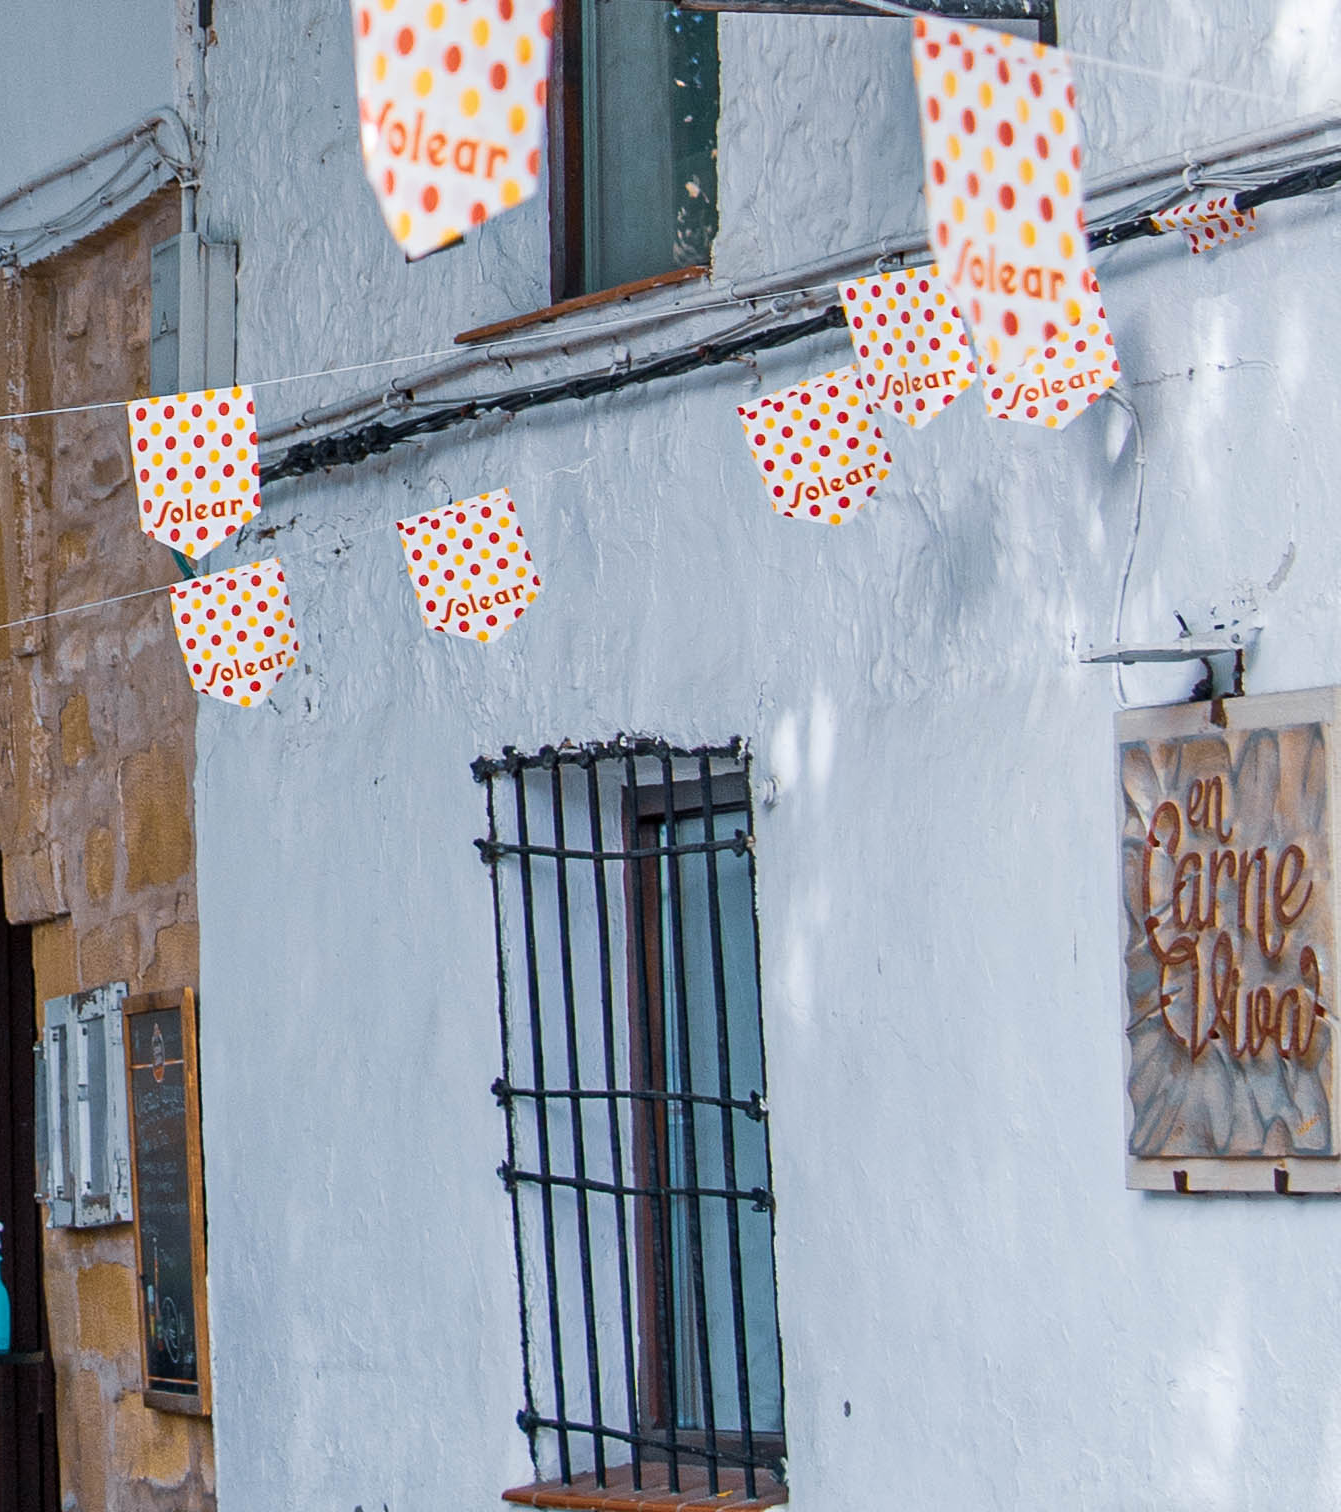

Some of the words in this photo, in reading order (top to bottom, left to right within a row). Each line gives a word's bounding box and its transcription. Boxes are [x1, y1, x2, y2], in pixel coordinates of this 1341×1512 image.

[153, 496, 244, 528] Solear
[1187, 775, 1232, 843] en
[1142, 800, 1313, 965] Carne
[1159, 931, 1320, 1062] Viva
